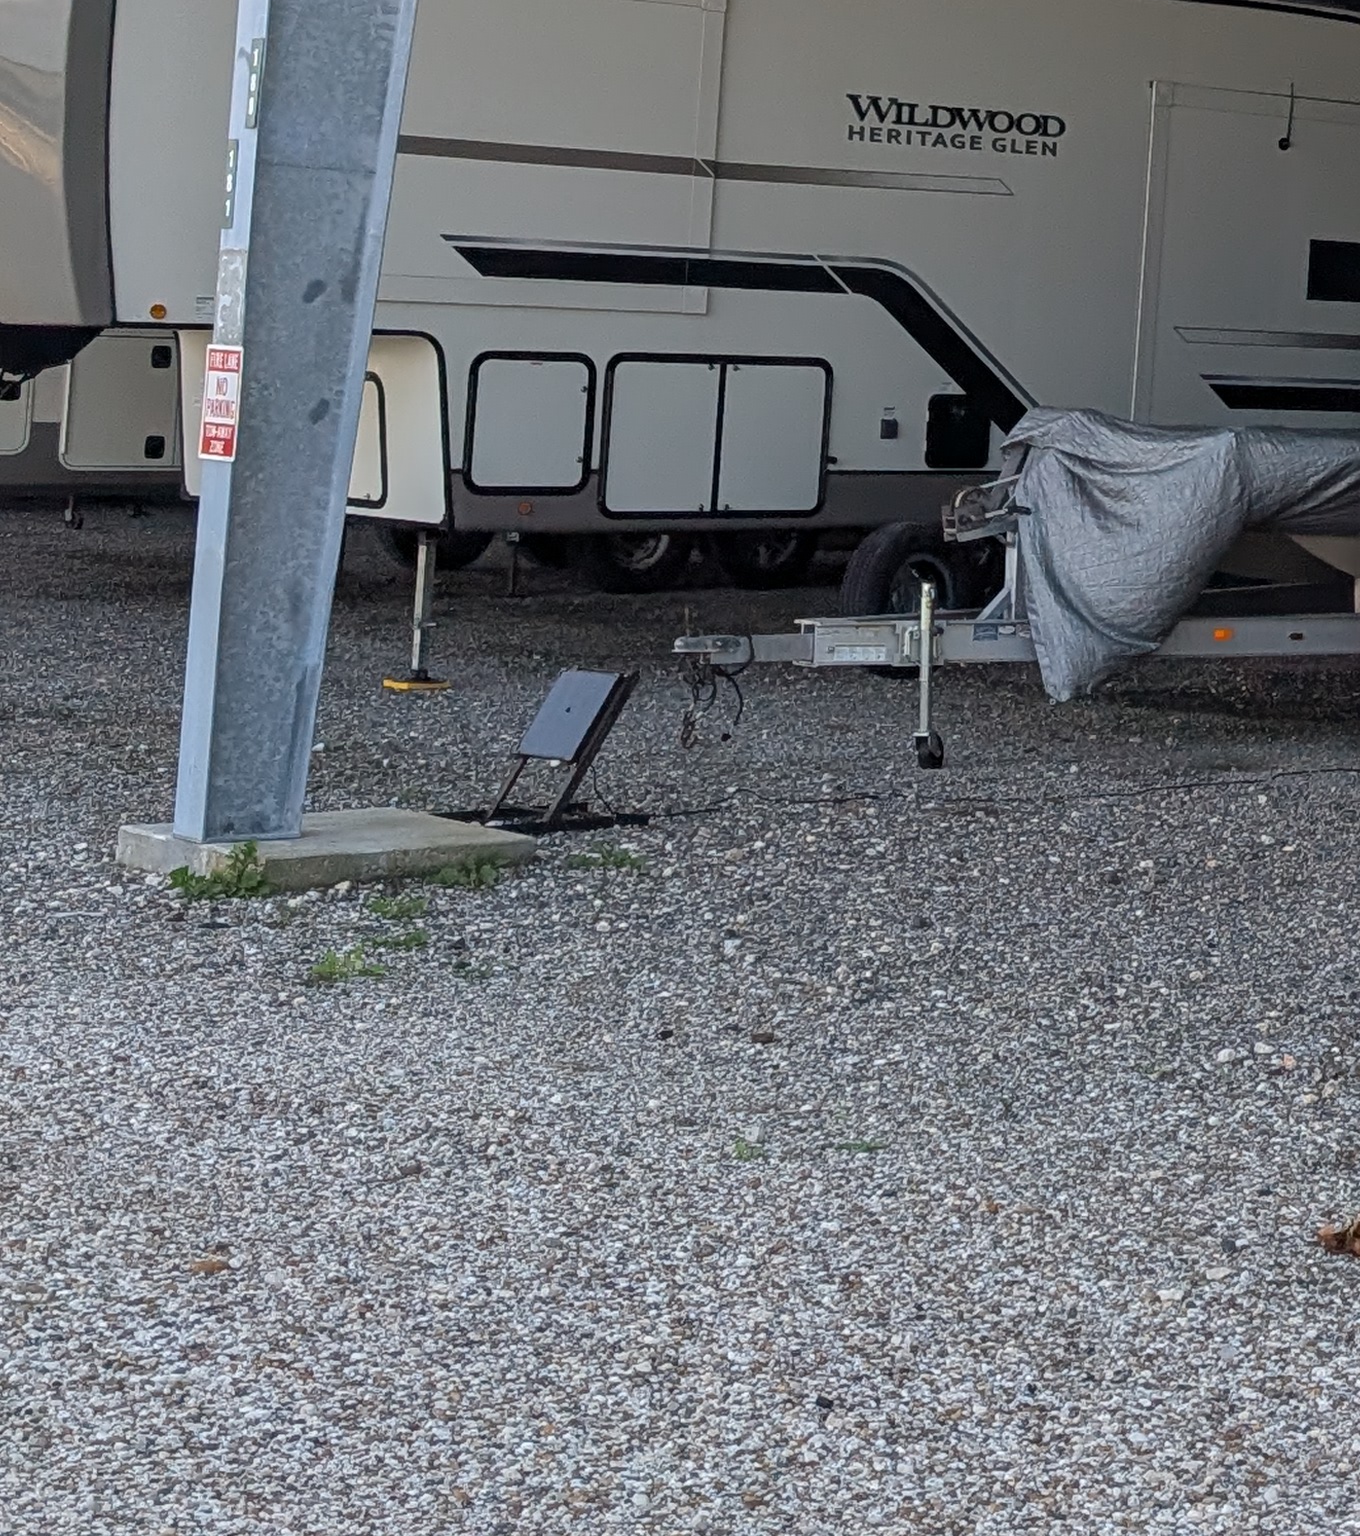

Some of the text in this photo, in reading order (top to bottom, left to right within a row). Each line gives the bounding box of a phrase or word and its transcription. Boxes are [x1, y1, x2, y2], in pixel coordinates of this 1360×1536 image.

[846, 93, 1066, 138] WILDWOOD
[848, 125, 1058, 157] HERITAGE GLEN
[224, 150, 235, 217] 181
[209, 352, 239, 370] FIRE LANE
[215, 377, 229, 396] NO
[205, 398, 236, 420] PARKING
[206, 424, 233, 440] TOW-AWAY
